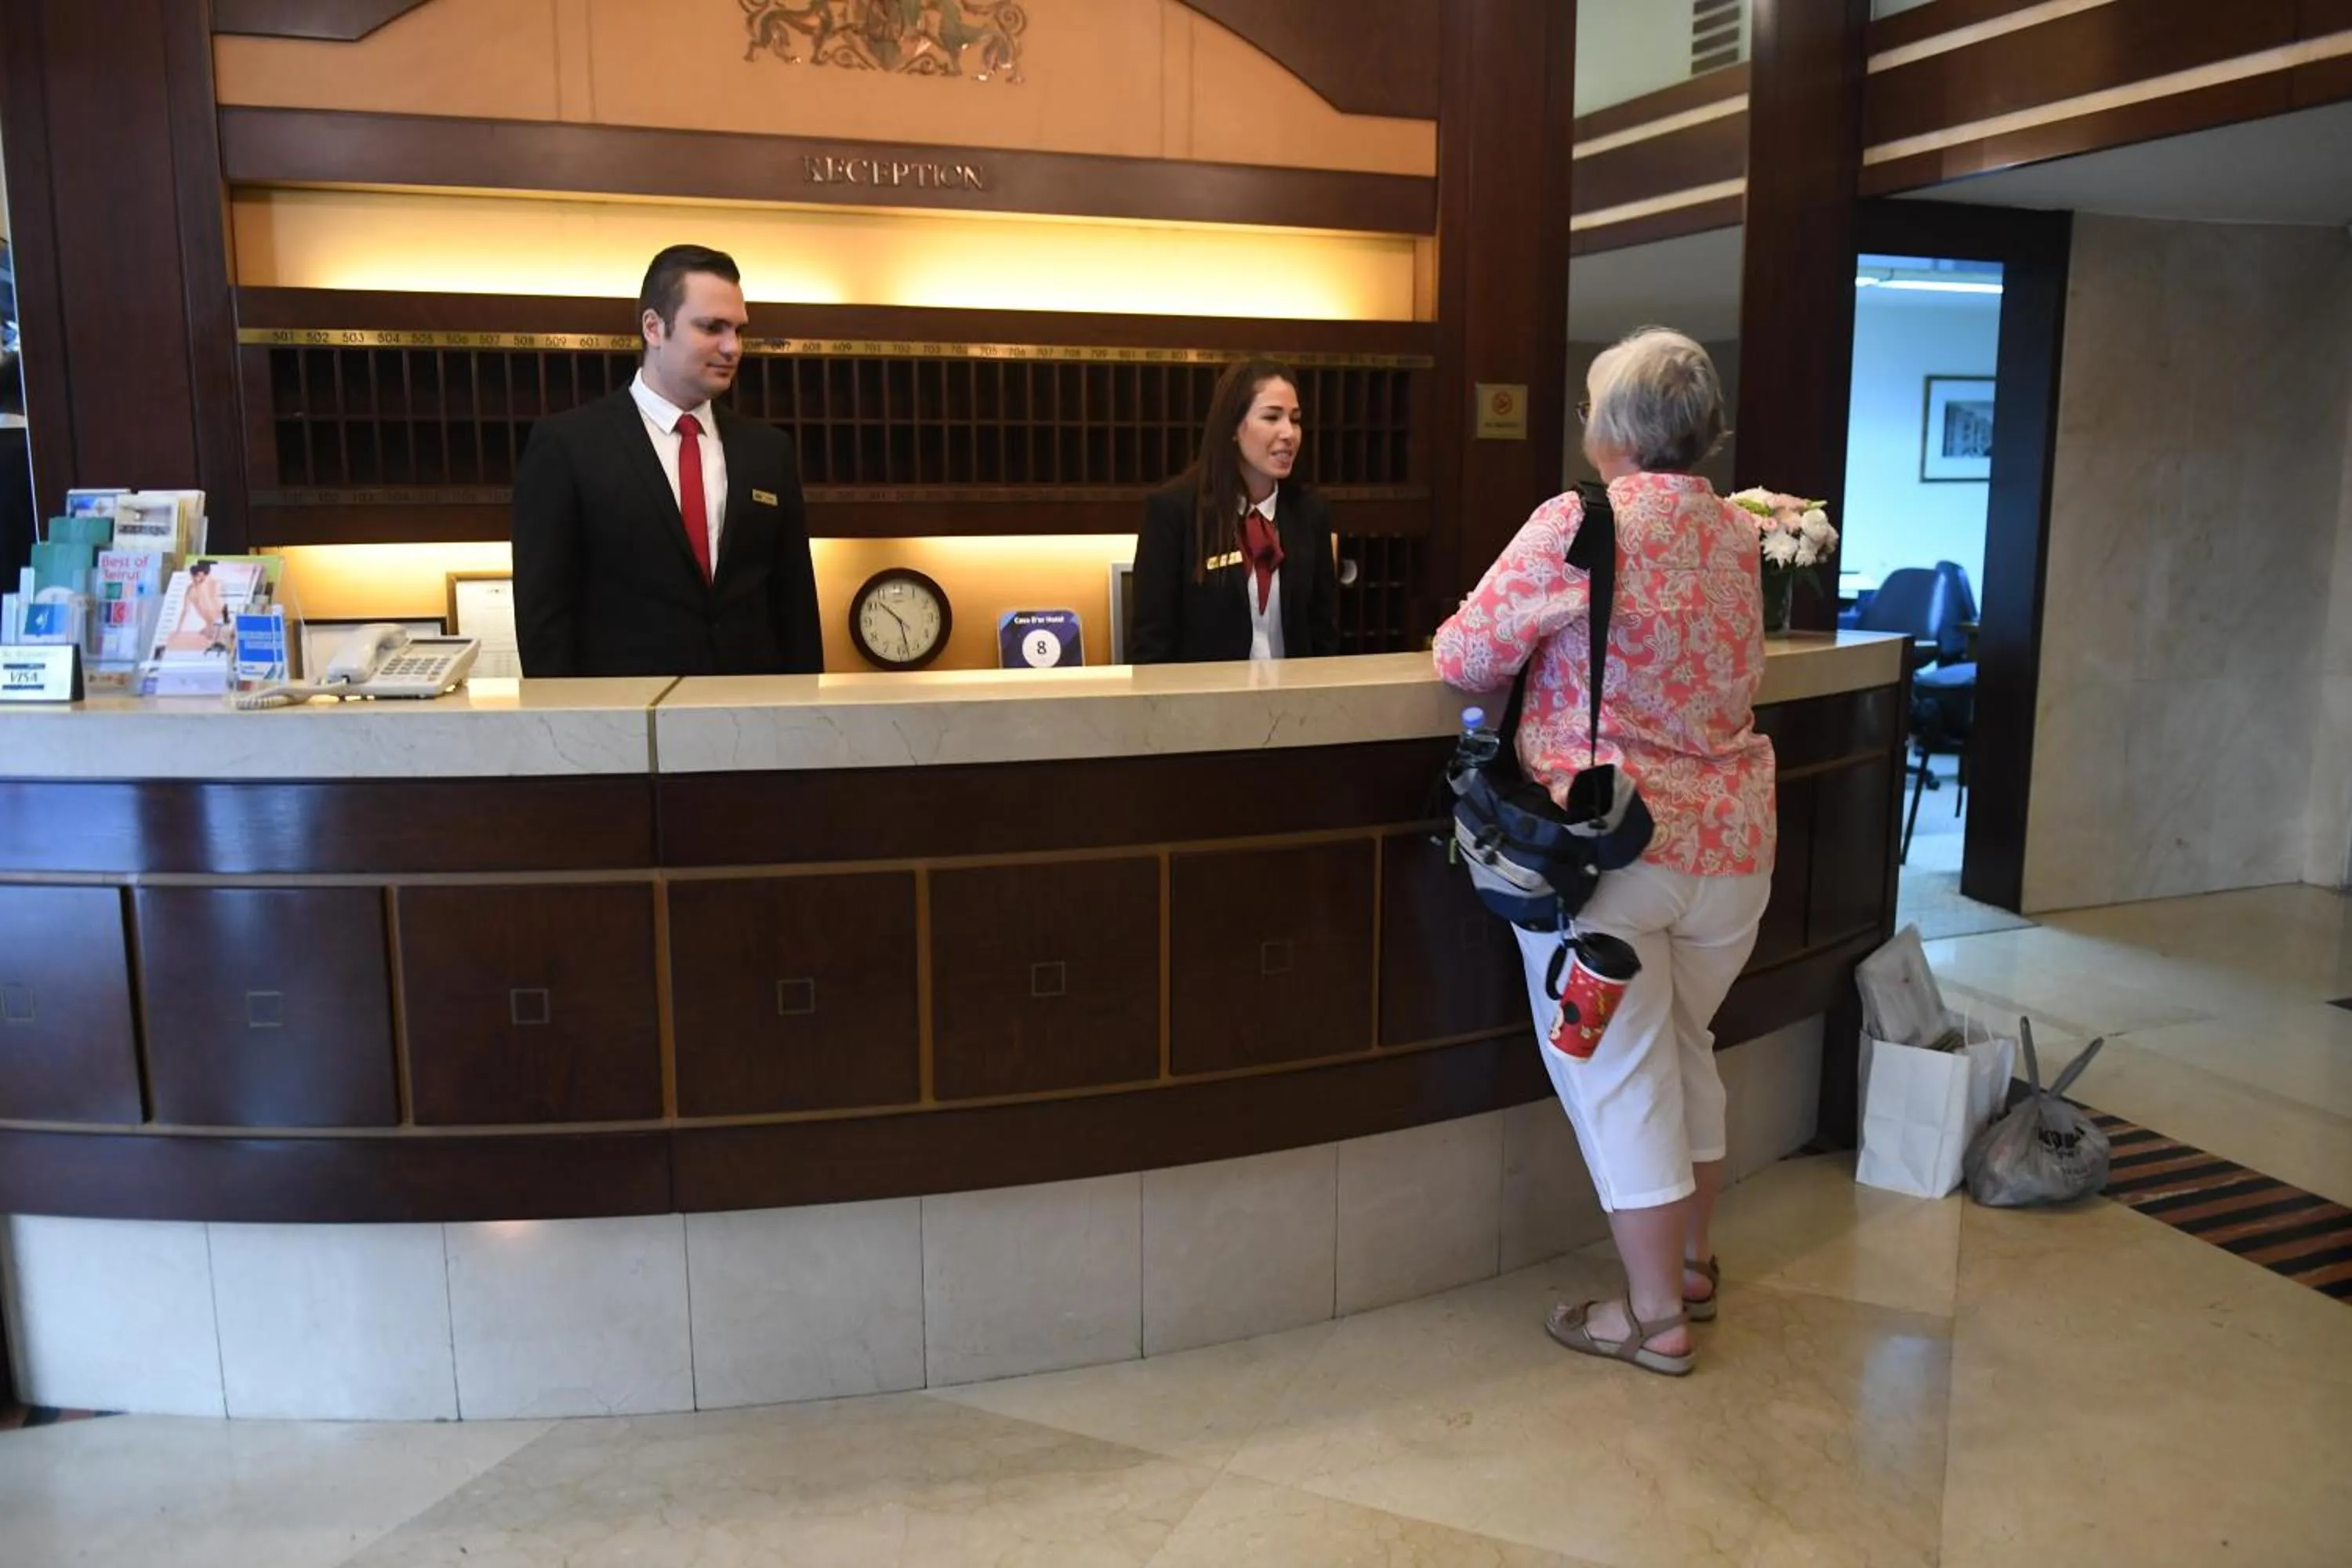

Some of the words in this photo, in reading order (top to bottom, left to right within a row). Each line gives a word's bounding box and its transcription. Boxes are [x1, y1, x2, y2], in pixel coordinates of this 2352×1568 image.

[803, 155, 985, 191] RECEPTION
[273, 331, 294, 342] 501
[307, 332, 329, 343] 502
[342, 332, 365, 343] 503
[377, 332, 400, 343] 504
[479, 335, 500, 345] 507
[546, 336, 567, 347] 509
[579, 337, 599, 347] 601
[922, 344, 941, 354] 703
[101, 555, 129, 567] Best
[135, 555, 150, 568] of
[877, 589, 887, 600] 11
[1036, 640, 1047, 655] 8
[10, 671, 38, 683] VISA
